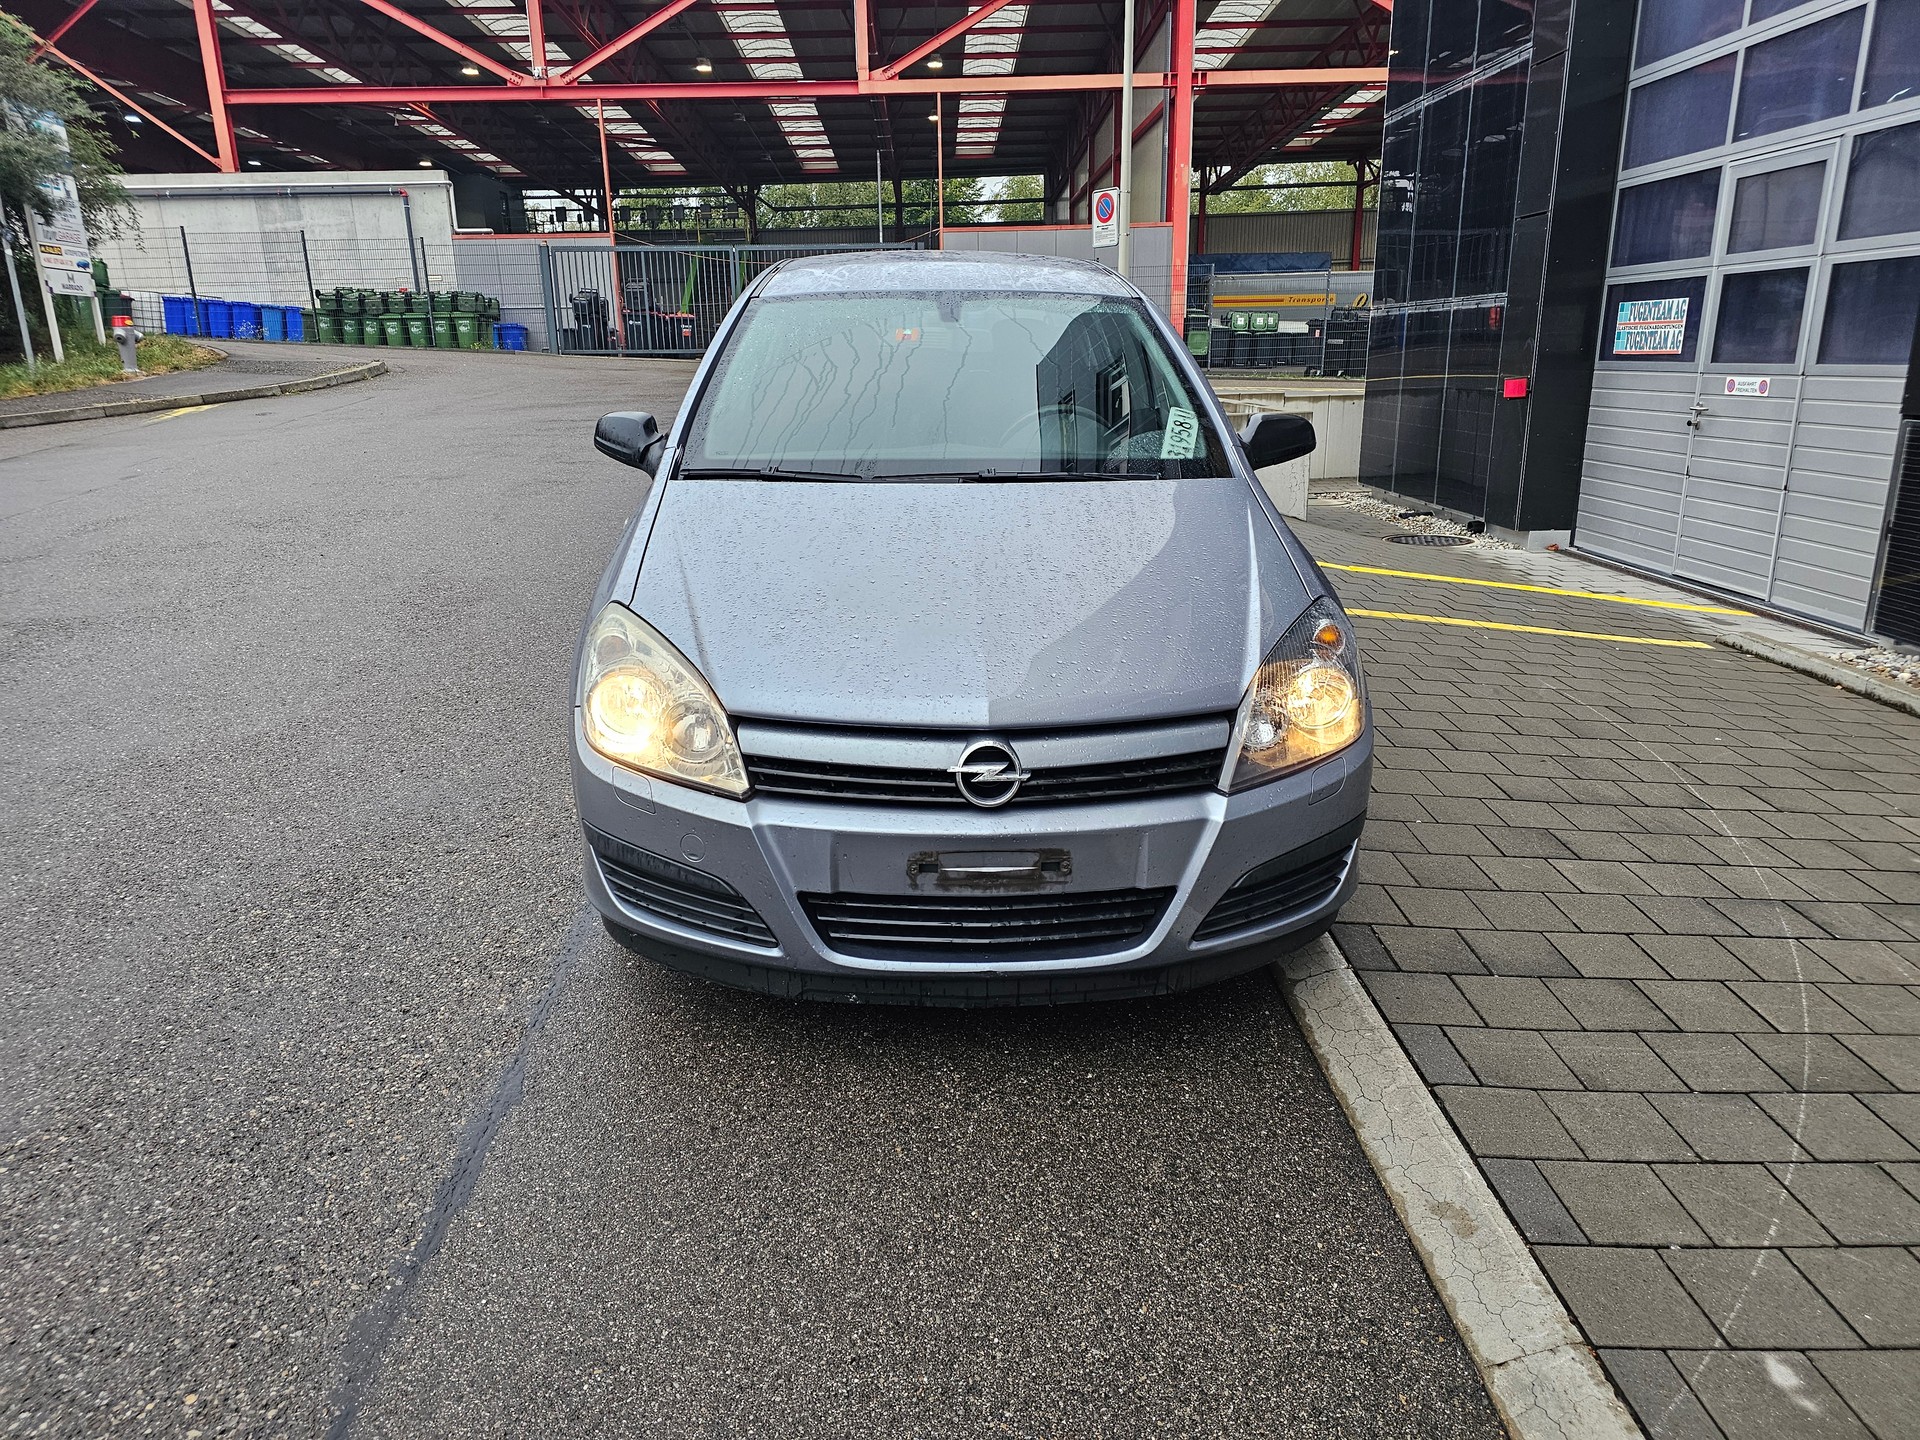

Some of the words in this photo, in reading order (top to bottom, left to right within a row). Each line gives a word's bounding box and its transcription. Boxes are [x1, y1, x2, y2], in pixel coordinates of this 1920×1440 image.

[1288, 296, 1334, 304] Transpore
[1628, 300, 1674, 322] FUGENTEAM
[1673, 299, 1687, 320] AG
[1625, 330, 1670, 351] FUGENTEAM
[1669, 330, 1682, 350] AG
